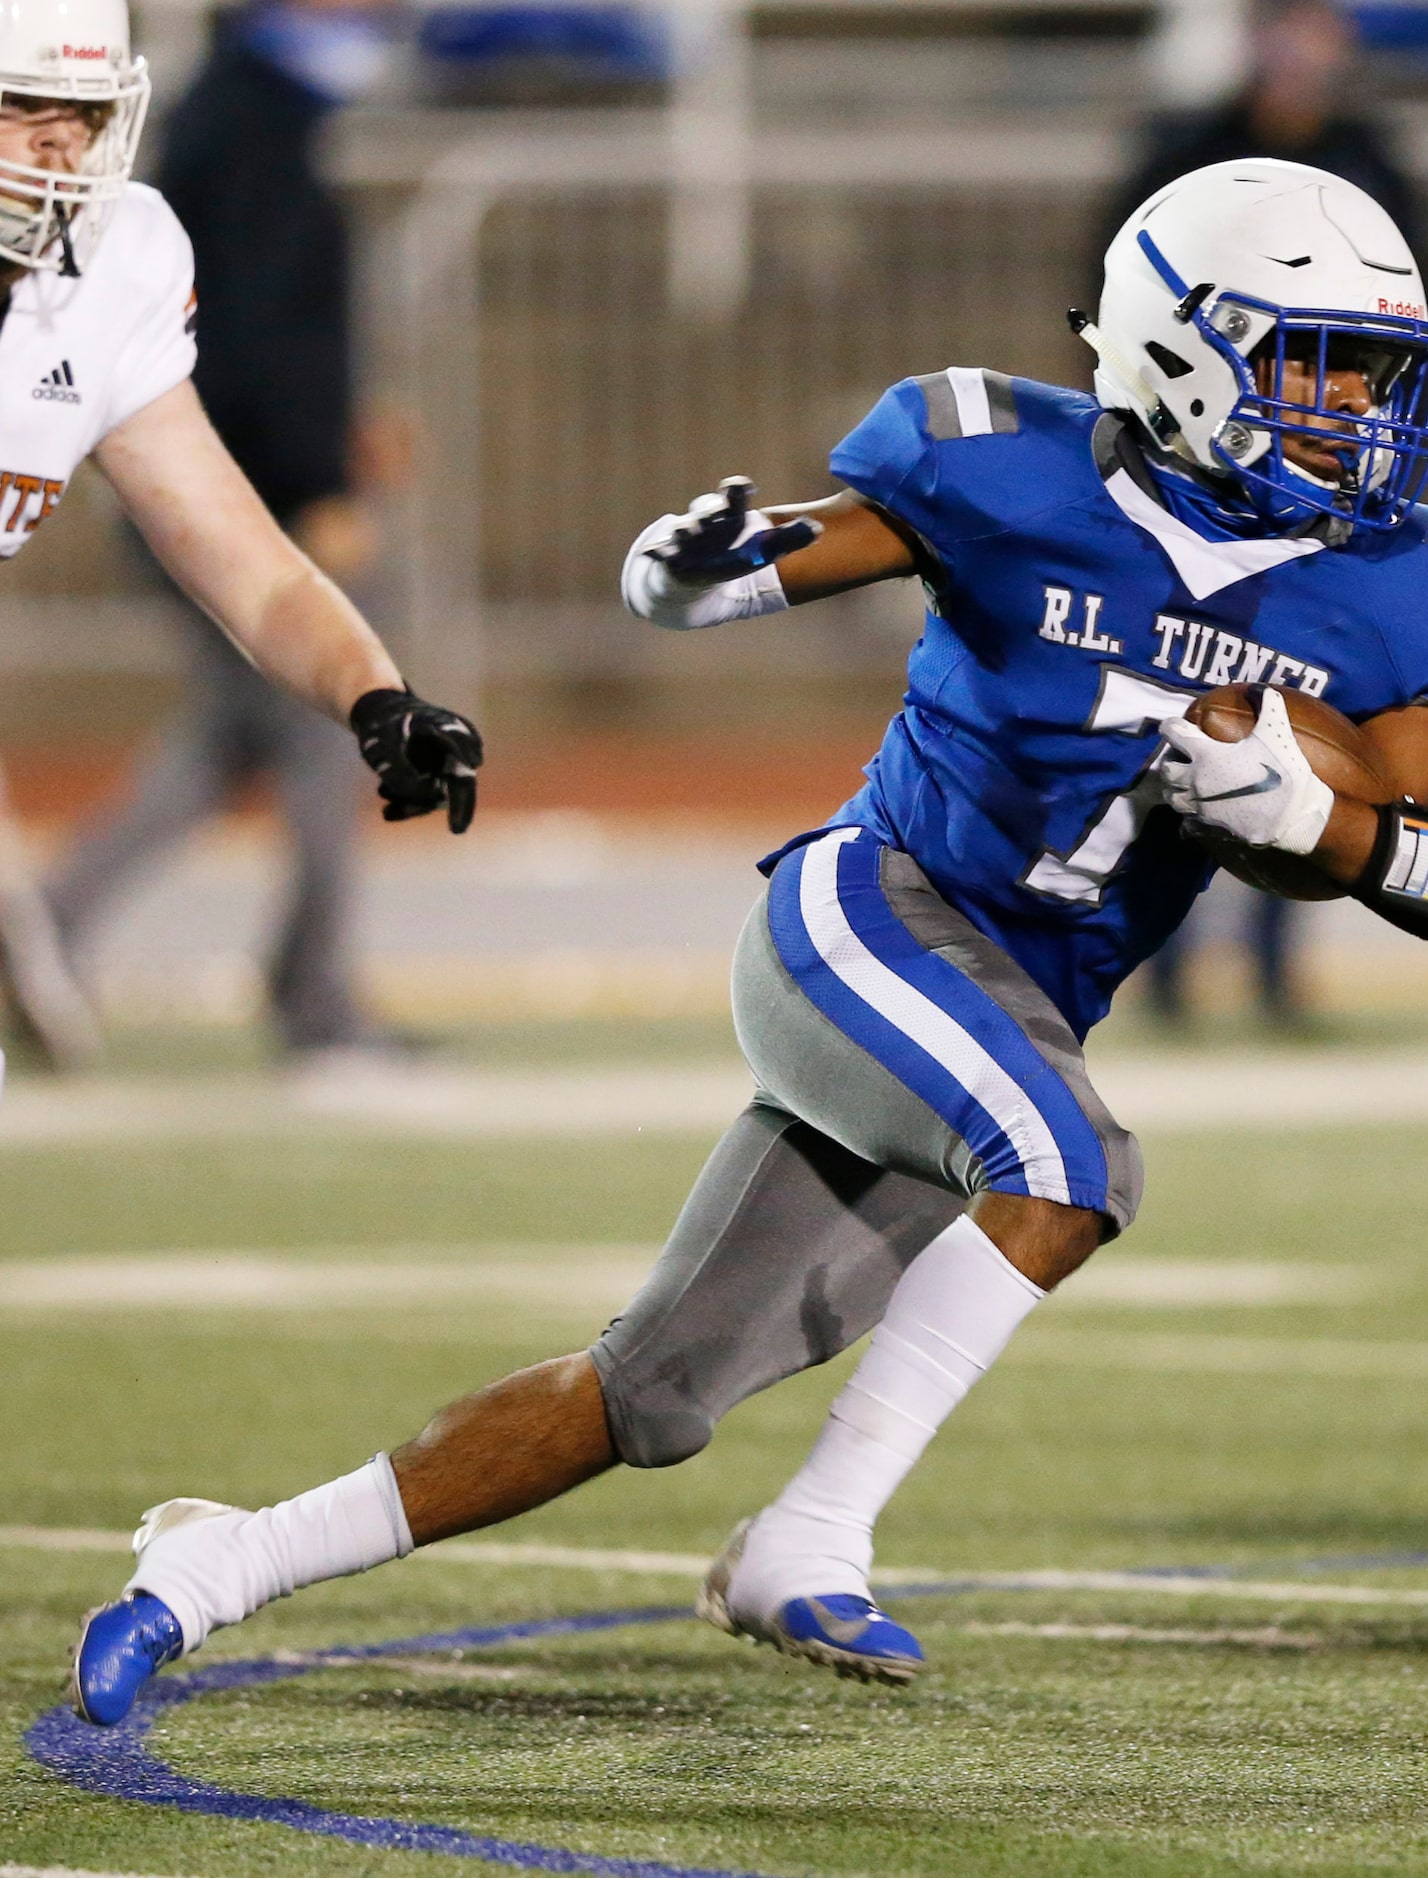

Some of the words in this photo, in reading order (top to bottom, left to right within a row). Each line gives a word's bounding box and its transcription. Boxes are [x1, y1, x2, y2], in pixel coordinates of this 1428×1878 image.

[31, 386, 83, 405] adidas
[1038, 583, 1124, 656] R.L.
[1018, 660, 1208, 909] 7
